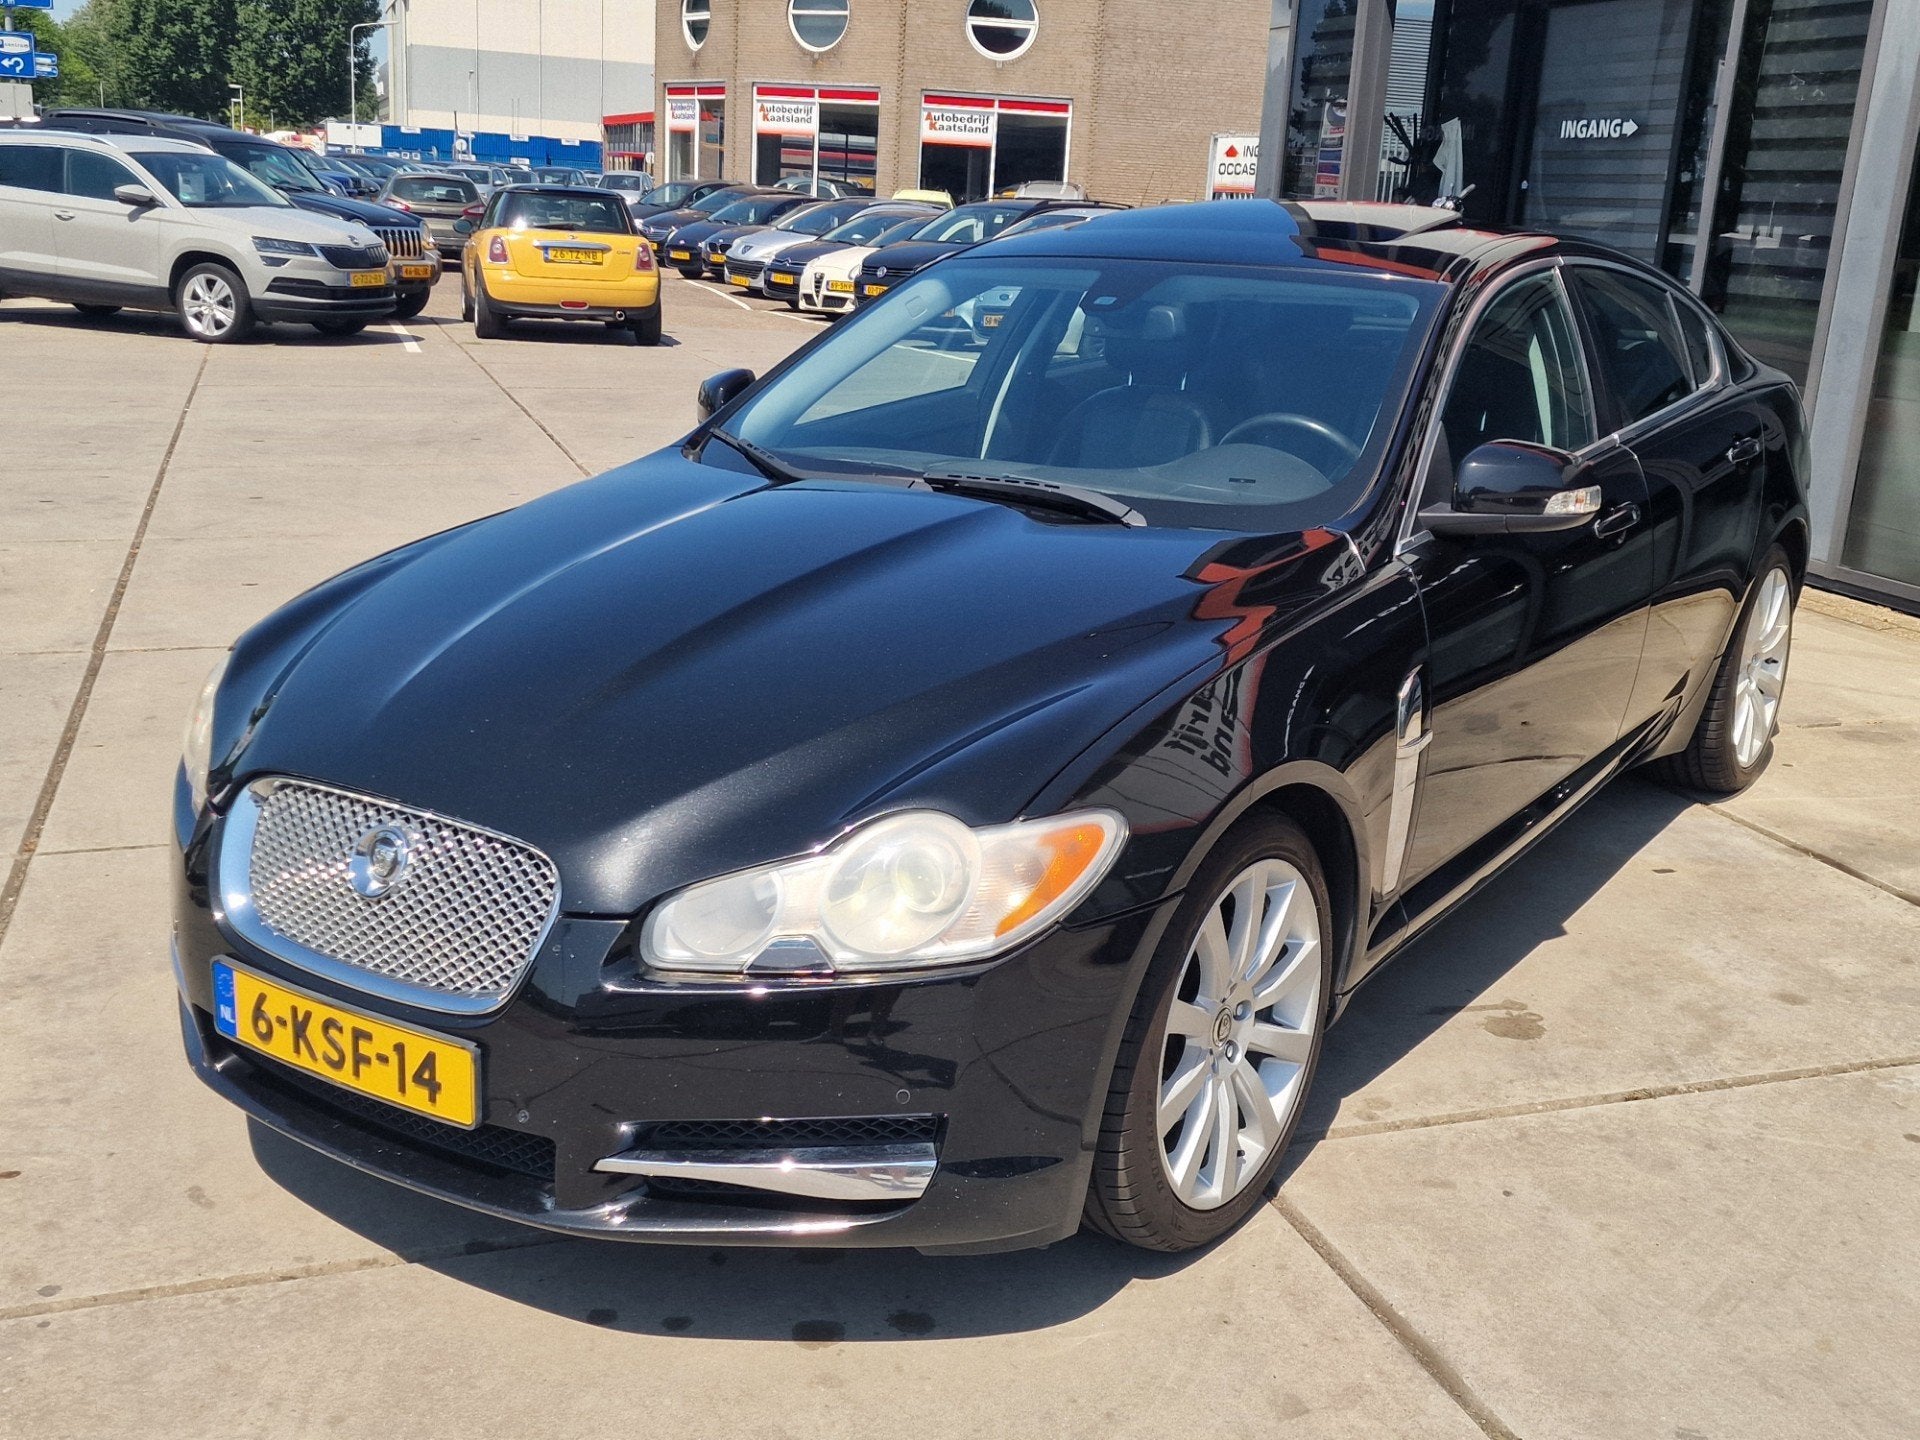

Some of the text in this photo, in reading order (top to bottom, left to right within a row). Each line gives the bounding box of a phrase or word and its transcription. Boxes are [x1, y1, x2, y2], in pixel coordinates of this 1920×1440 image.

[759, 104, 813, 116] Autobedrijf
[762, 113, 812, 124] Kaatsland
[925, 112, 990, 126] Autobedrijf
[929, 122, 989, 134] Kaatsland
[1560, 119, 1621, 138] INGANG
[1218, 163, 1256, 175] OCCAS
[220, 1004, 236, 1024] NL
[251, 992, 442, 1106] 6-KSF-14
